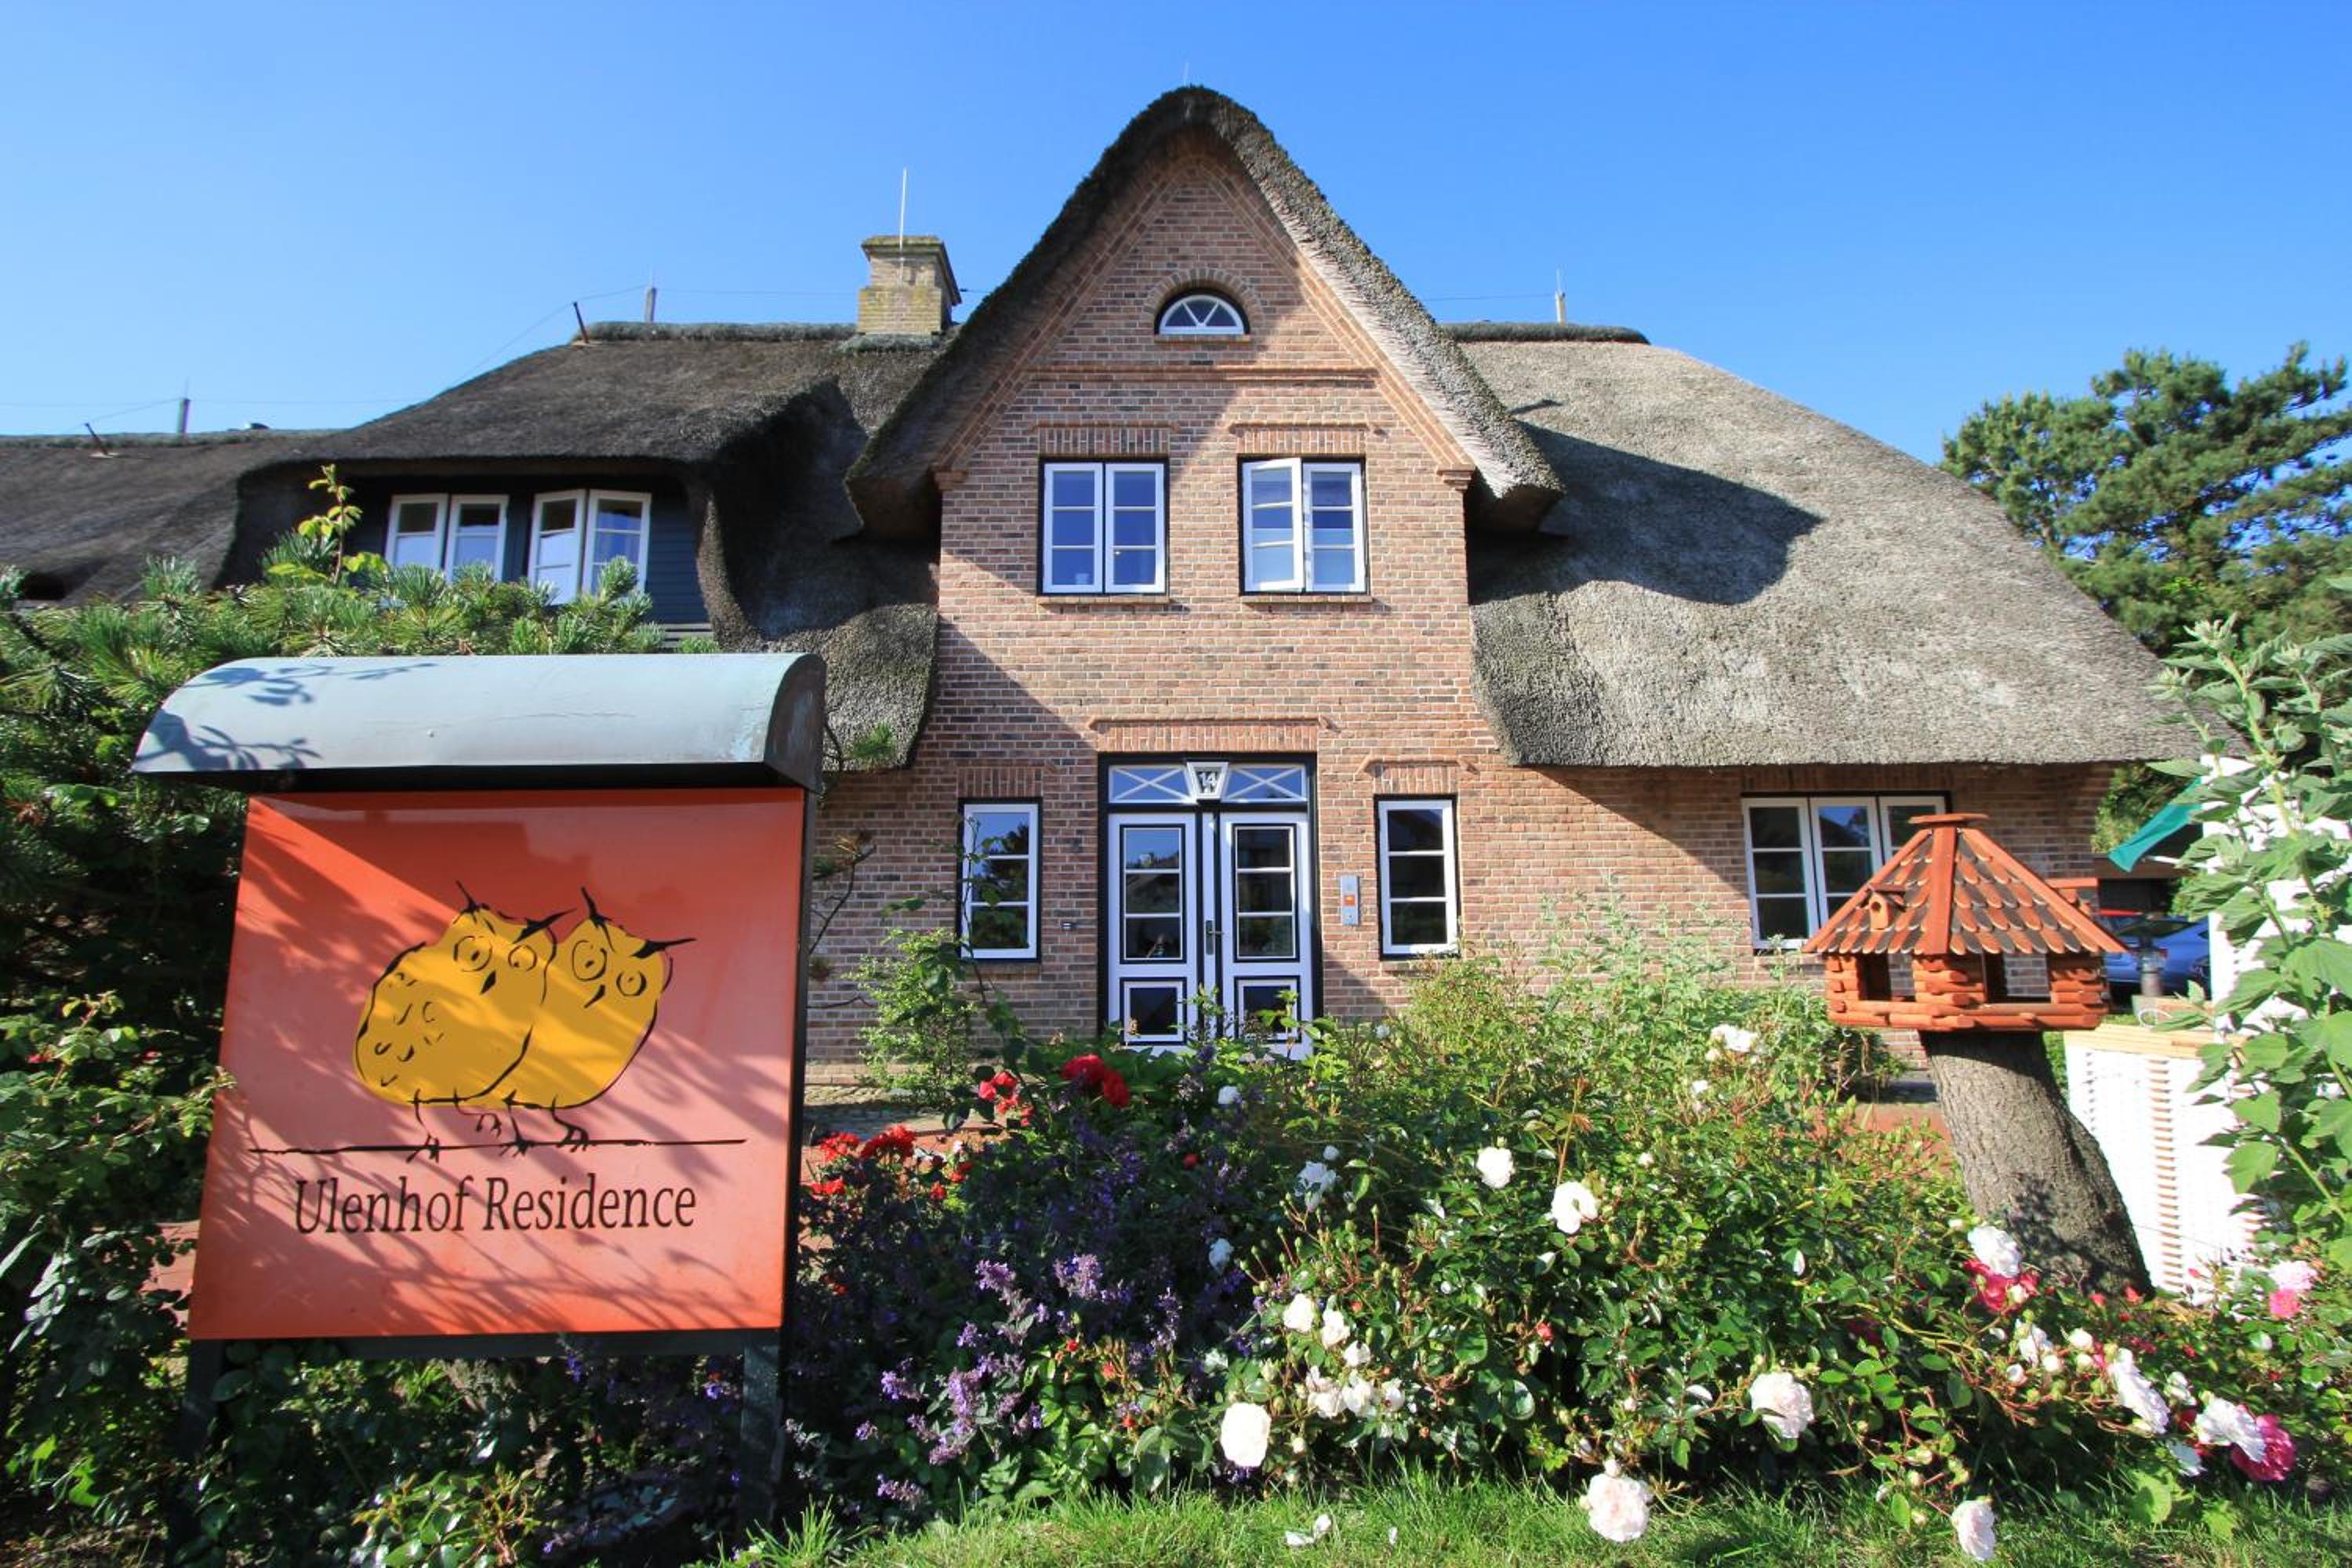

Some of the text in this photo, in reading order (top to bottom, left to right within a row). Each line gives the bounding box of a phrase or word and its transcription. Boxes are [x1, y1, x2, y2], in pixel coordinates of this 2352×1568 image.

[1199, 771, 1218, 787] 14
[296, 1173, 696, 1233] Ulenhof Residence
